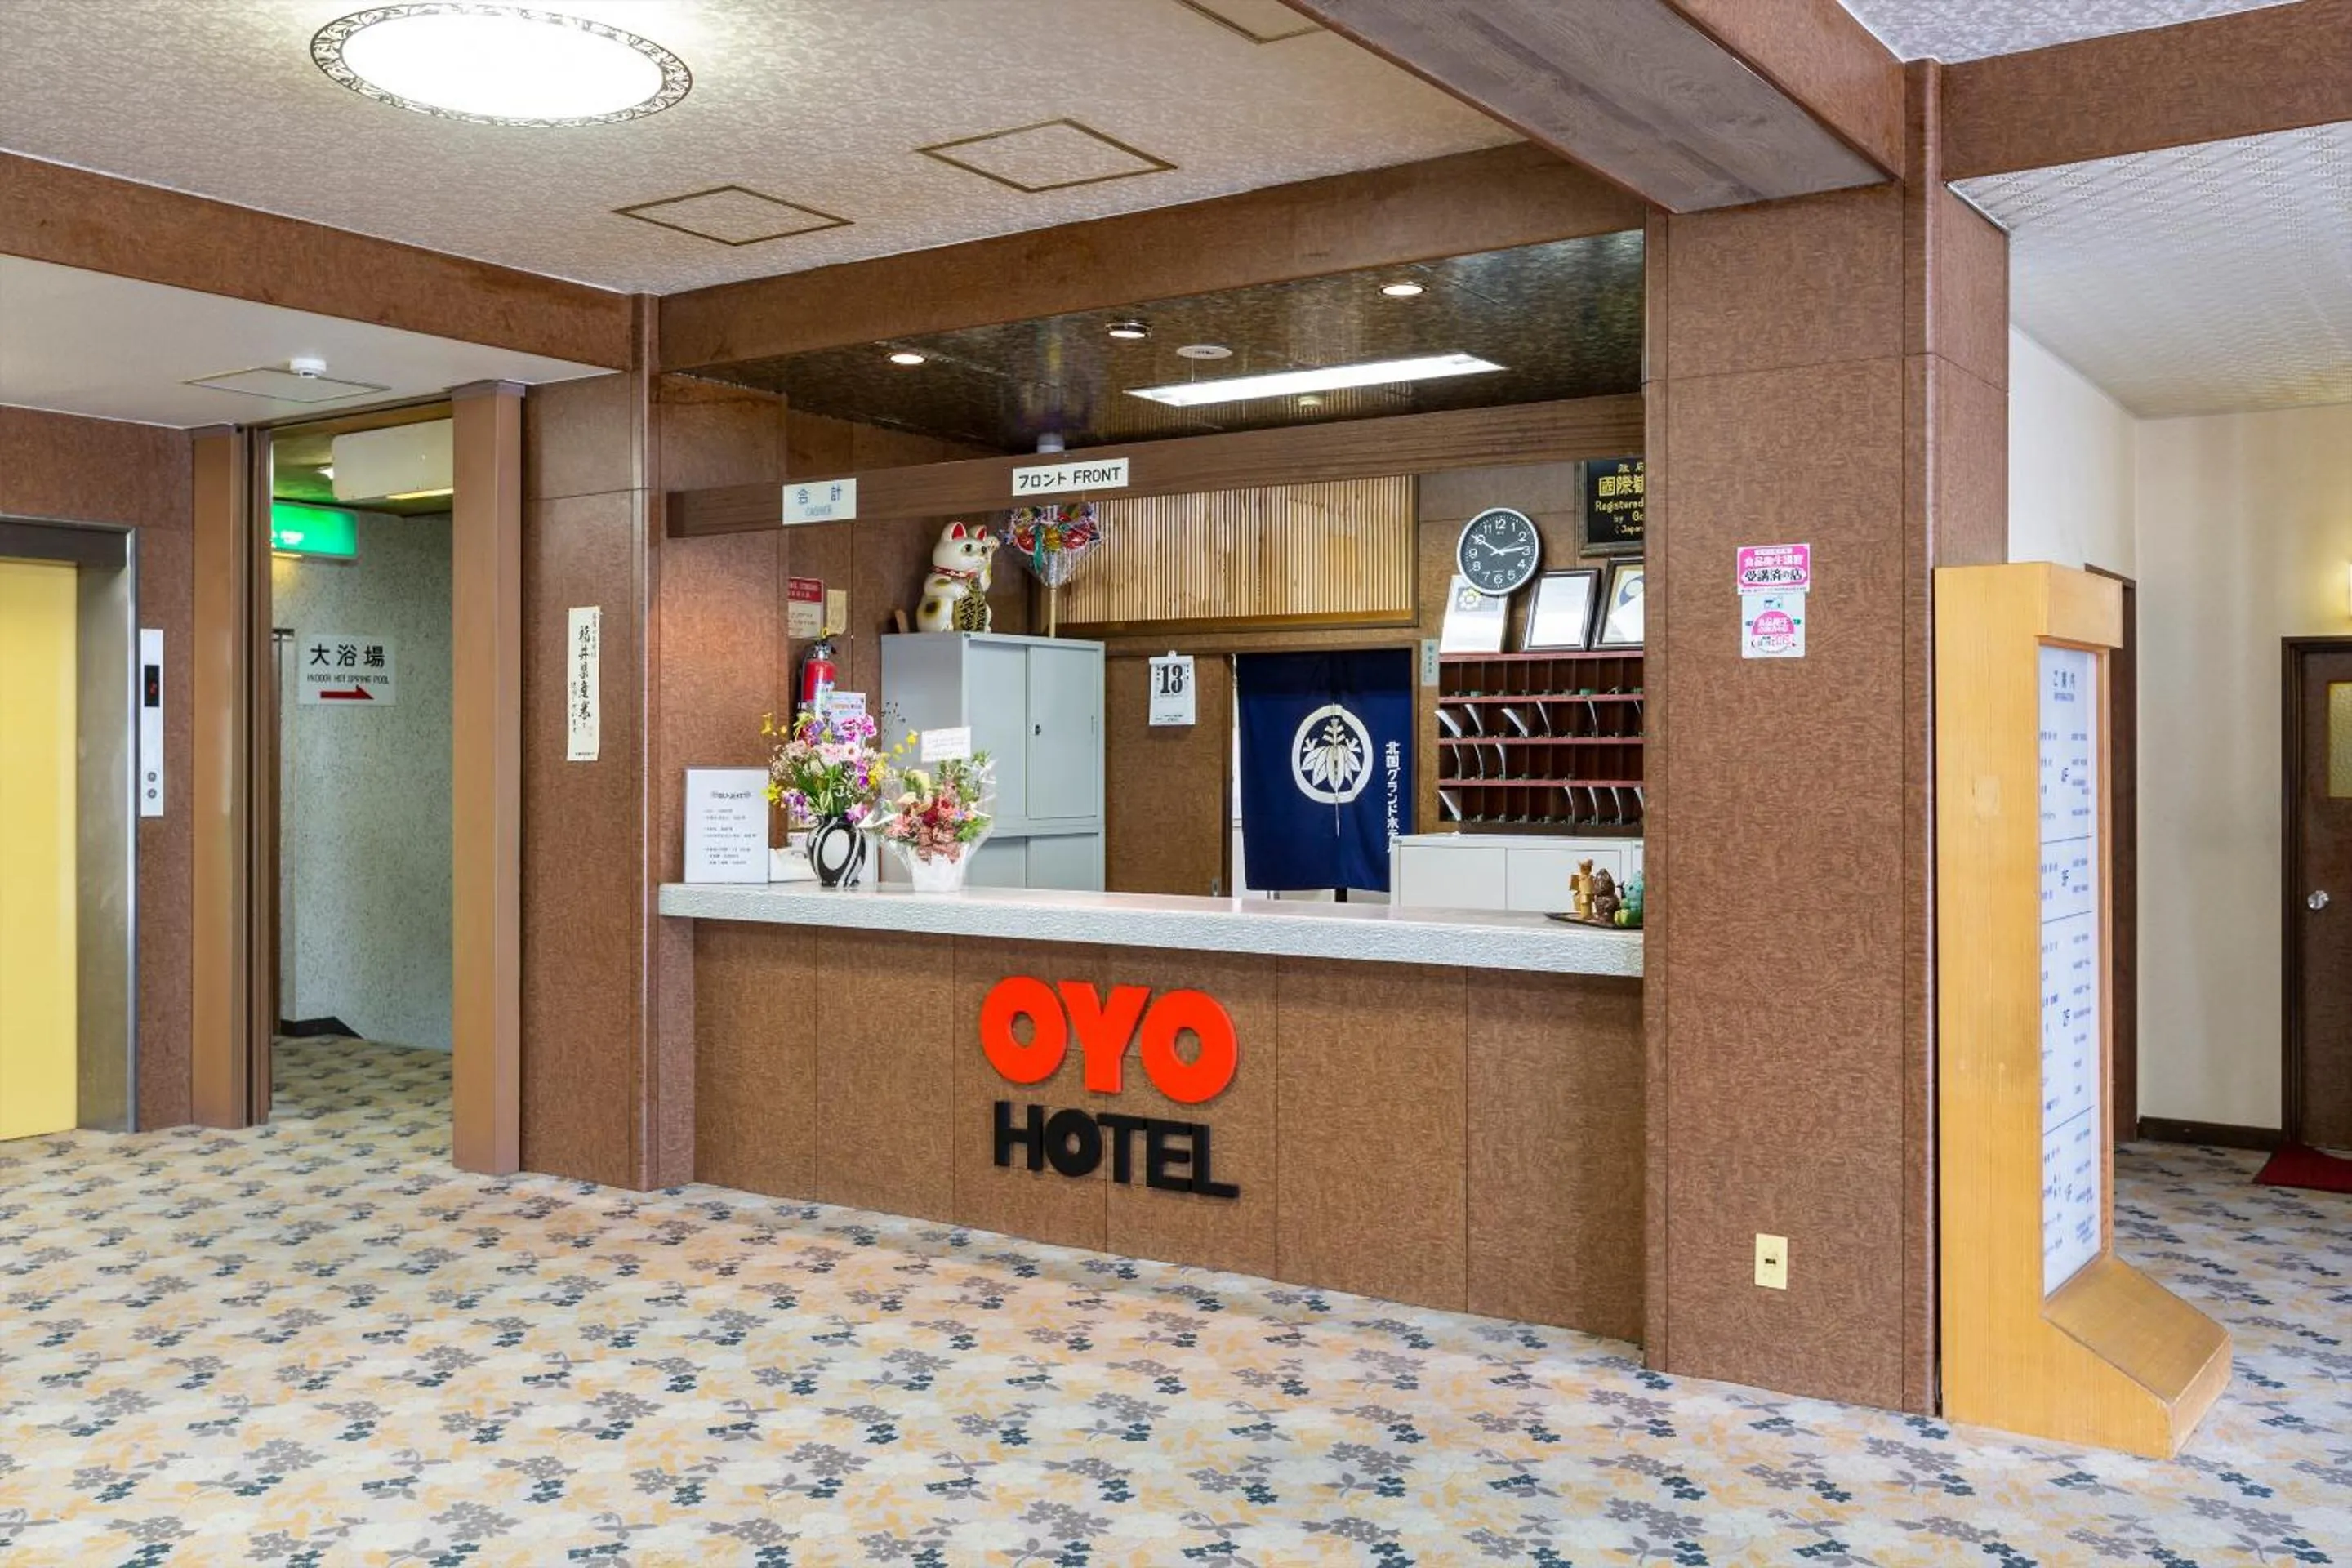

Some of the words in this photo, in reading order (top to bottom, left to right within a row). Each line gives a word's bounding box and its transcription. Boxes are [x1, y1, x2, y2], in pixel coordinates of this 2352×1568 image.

[1018, 472, 1067, 488] フロント
[1073, 467, 1121, 484] FRONT
[798, 482, 842, 504] 会計
[1595, 497, 1645, 514] Registered
[1484, 523, 1492, 534] 11
[1495, 519, 1506, 529] 12
[1512, 522, 1516, 532] 1
[1518, 531, 1526, 542] 2
[1469, 548, 1477, 559] 9
[1521, 546, 1531, 555] 3
[1472, 561, 1481, 571] 8
[1517, 559, 1526, 569] 4
[1482, 571, 1490, 581] 7
[1494, 574, 1503, 585] 6
[1507, 570, 1515, 581] 5
[310, 643, 385, 667] 大浴場
[1160, 664, 1183, 694] 13
[980, 975, 1239, 1105] OYO
[993, 1100, 1240, 1199] HOTEL
